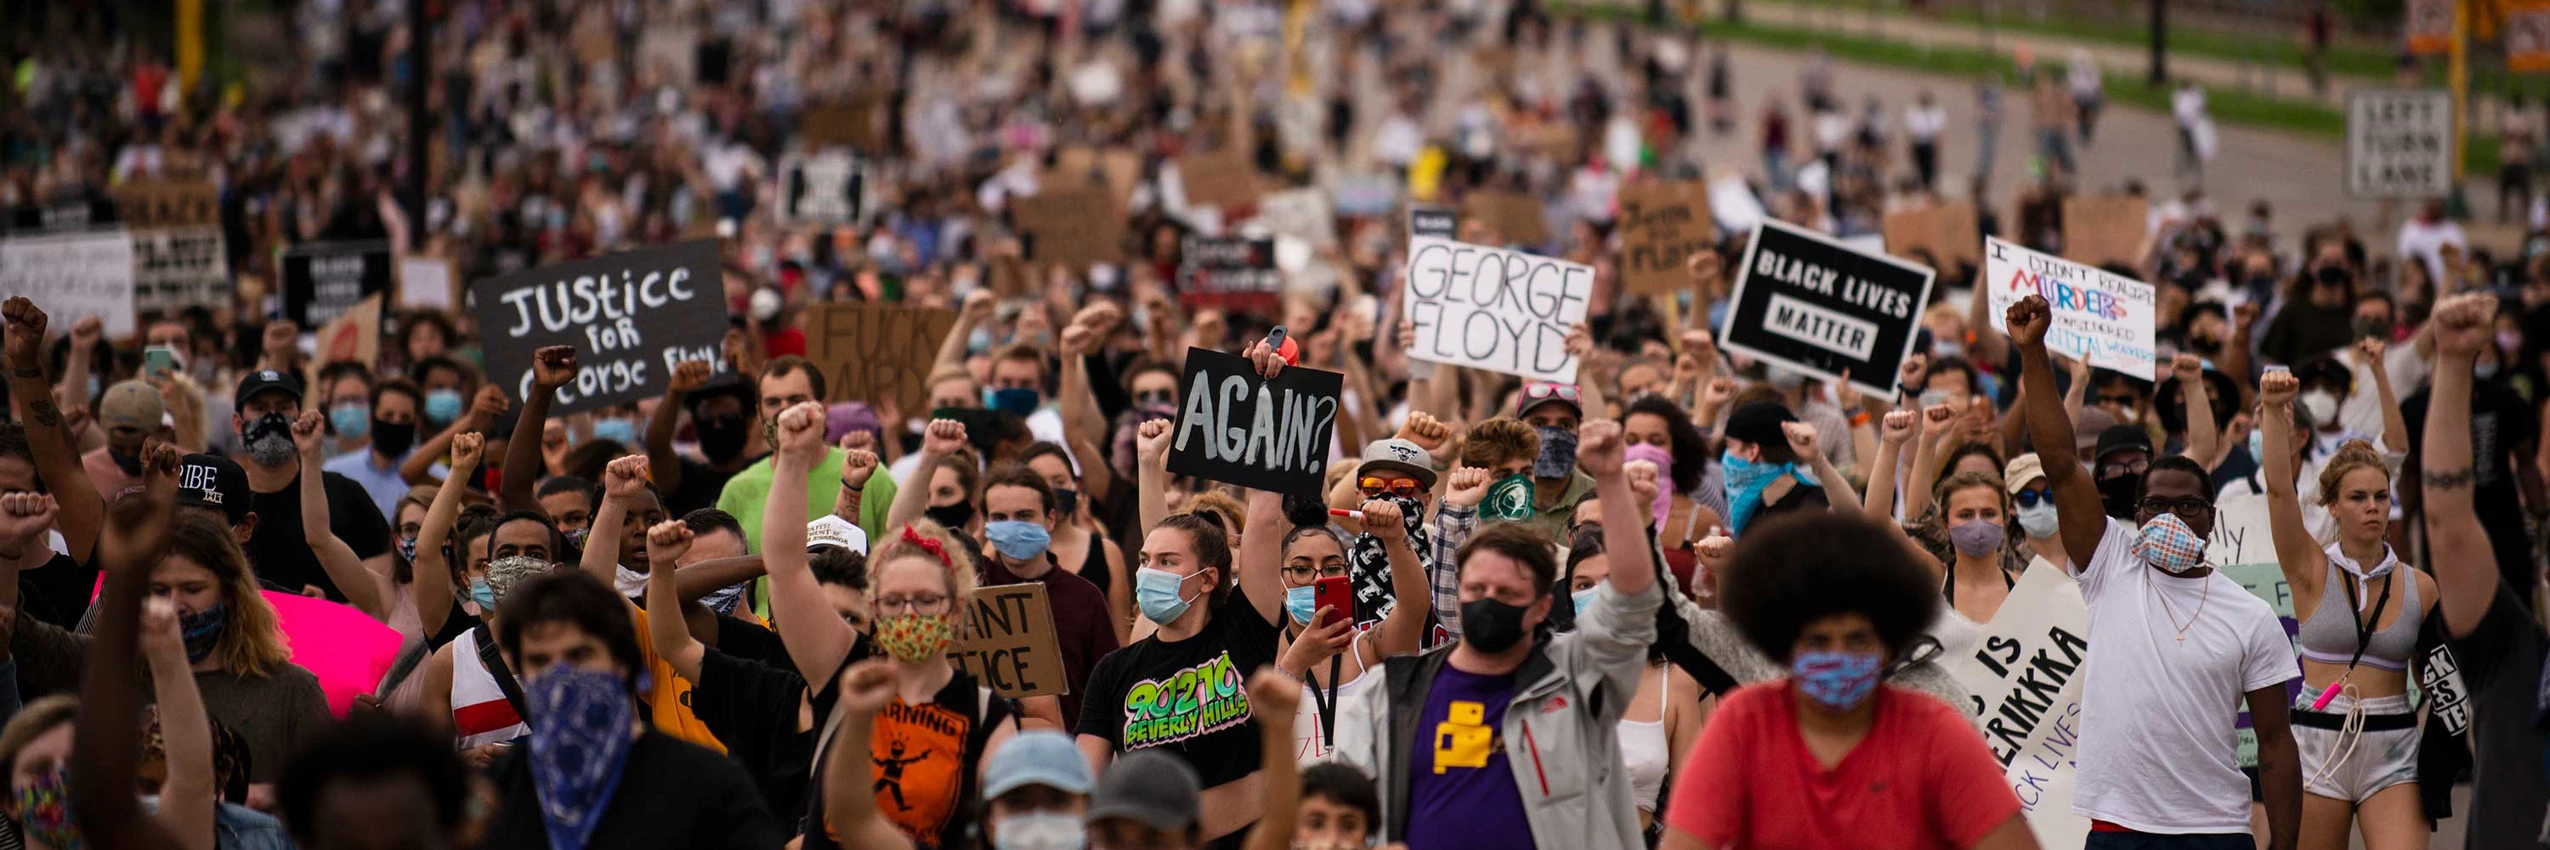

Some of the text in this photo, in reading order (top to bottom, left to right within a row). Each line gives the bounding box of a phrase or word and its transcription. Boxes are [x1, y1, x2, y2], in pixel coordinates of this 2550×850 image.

[2363, 101, 2435, 122] LEFT
[2362, 132, 2441, 153] TURN
[2358, 163, 2435, 185] LANE
[1410, 244, 1586, 326] GEORGE
[1756, 249, 1912, 319] BLACK LIVES
[1991, 242, 2008, 262] I
[2029, 255, 2090, 281] DIDN'T
[2010, 268, 2127, 320] MURDERS
[1412, 300, 1570, 373] FLOYD
[1776, 306, 1866, 351] MATTER
[1175, 369, 1337, 474] AGAIN?
[1975, 636, 2021, 679] IS
[1127, 653, 1237, 720] 90210
[1126, 693, 1248, 745] BEVERLY HILLS
[2020, 770, 2049, 811] CK
